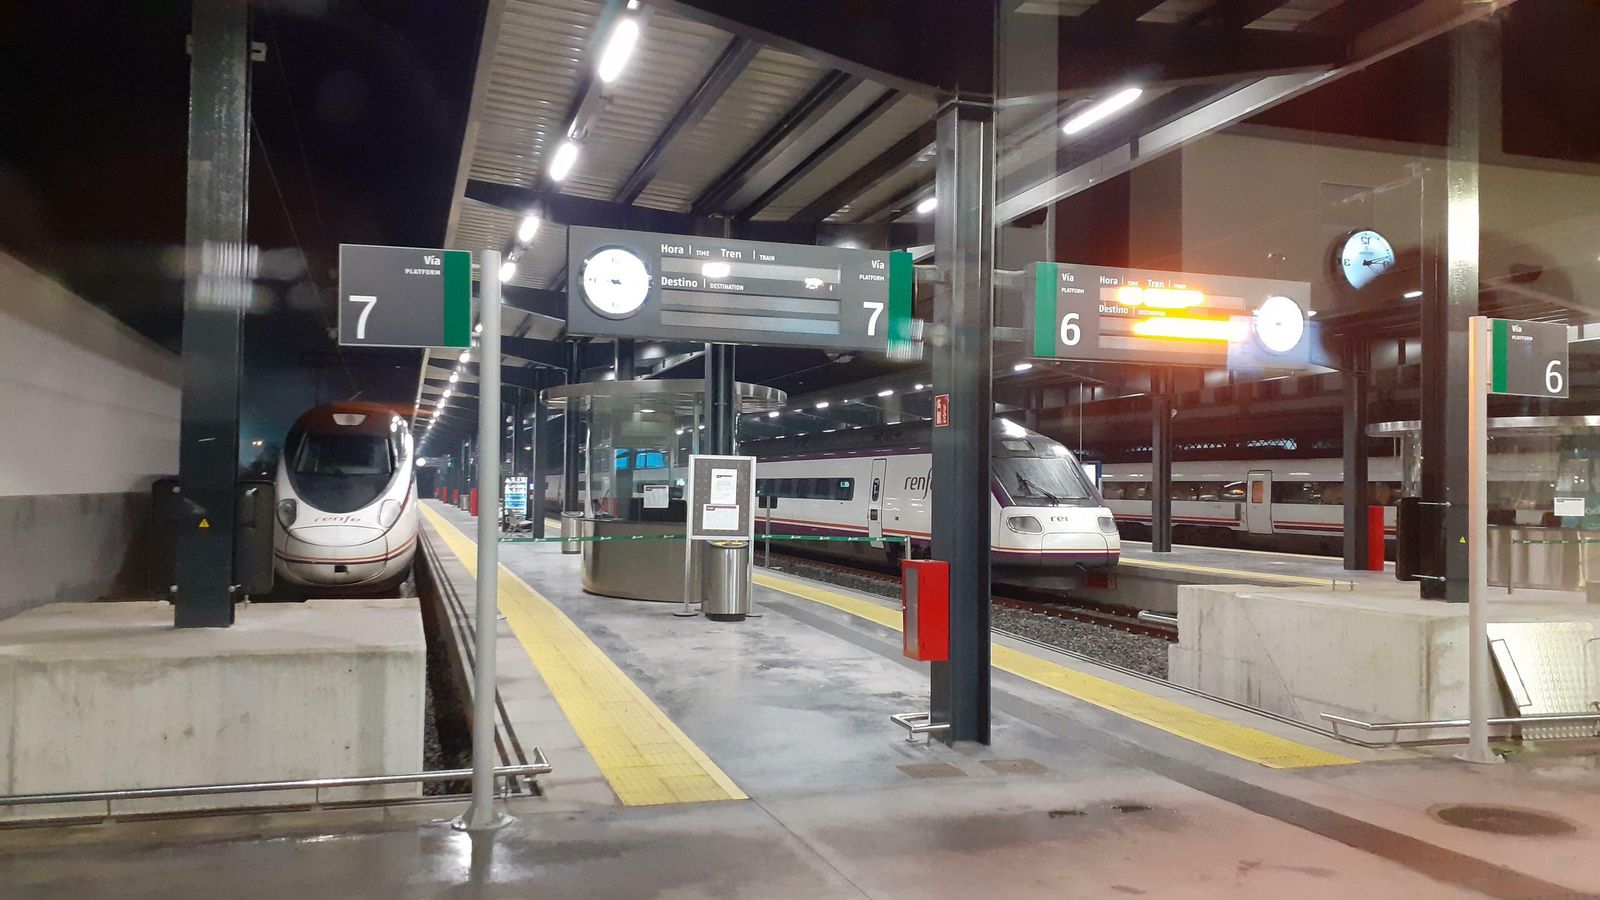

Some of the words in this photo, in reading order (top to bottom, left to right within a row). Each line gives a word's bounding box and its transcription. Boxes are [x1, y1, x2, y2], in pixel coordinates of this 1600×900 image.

[661, 244, 684, 254] Hora
[721, 249, 742, 259] Tren
[424, 255, 441, 266] Vía
[871, 260, 885, 269] Vía
[405, 268, 441, 276] PLATFORM
[1062, 273, 1074, 282] Vía
[661, 277, 698, 288] Destino
[709, 282, 744, 291] DESTINATION
[1100, 276, 1118, 285] Hora
[1147, 279, 1165, 288] Tren
[1099, 304, 1128, 314] Destino
[349, 295, 377, 339] 7
[863, 301, 884, 336] 7
[1060, 313, 1081, 346] 6
[1545, 360, 1563, 393] 6
